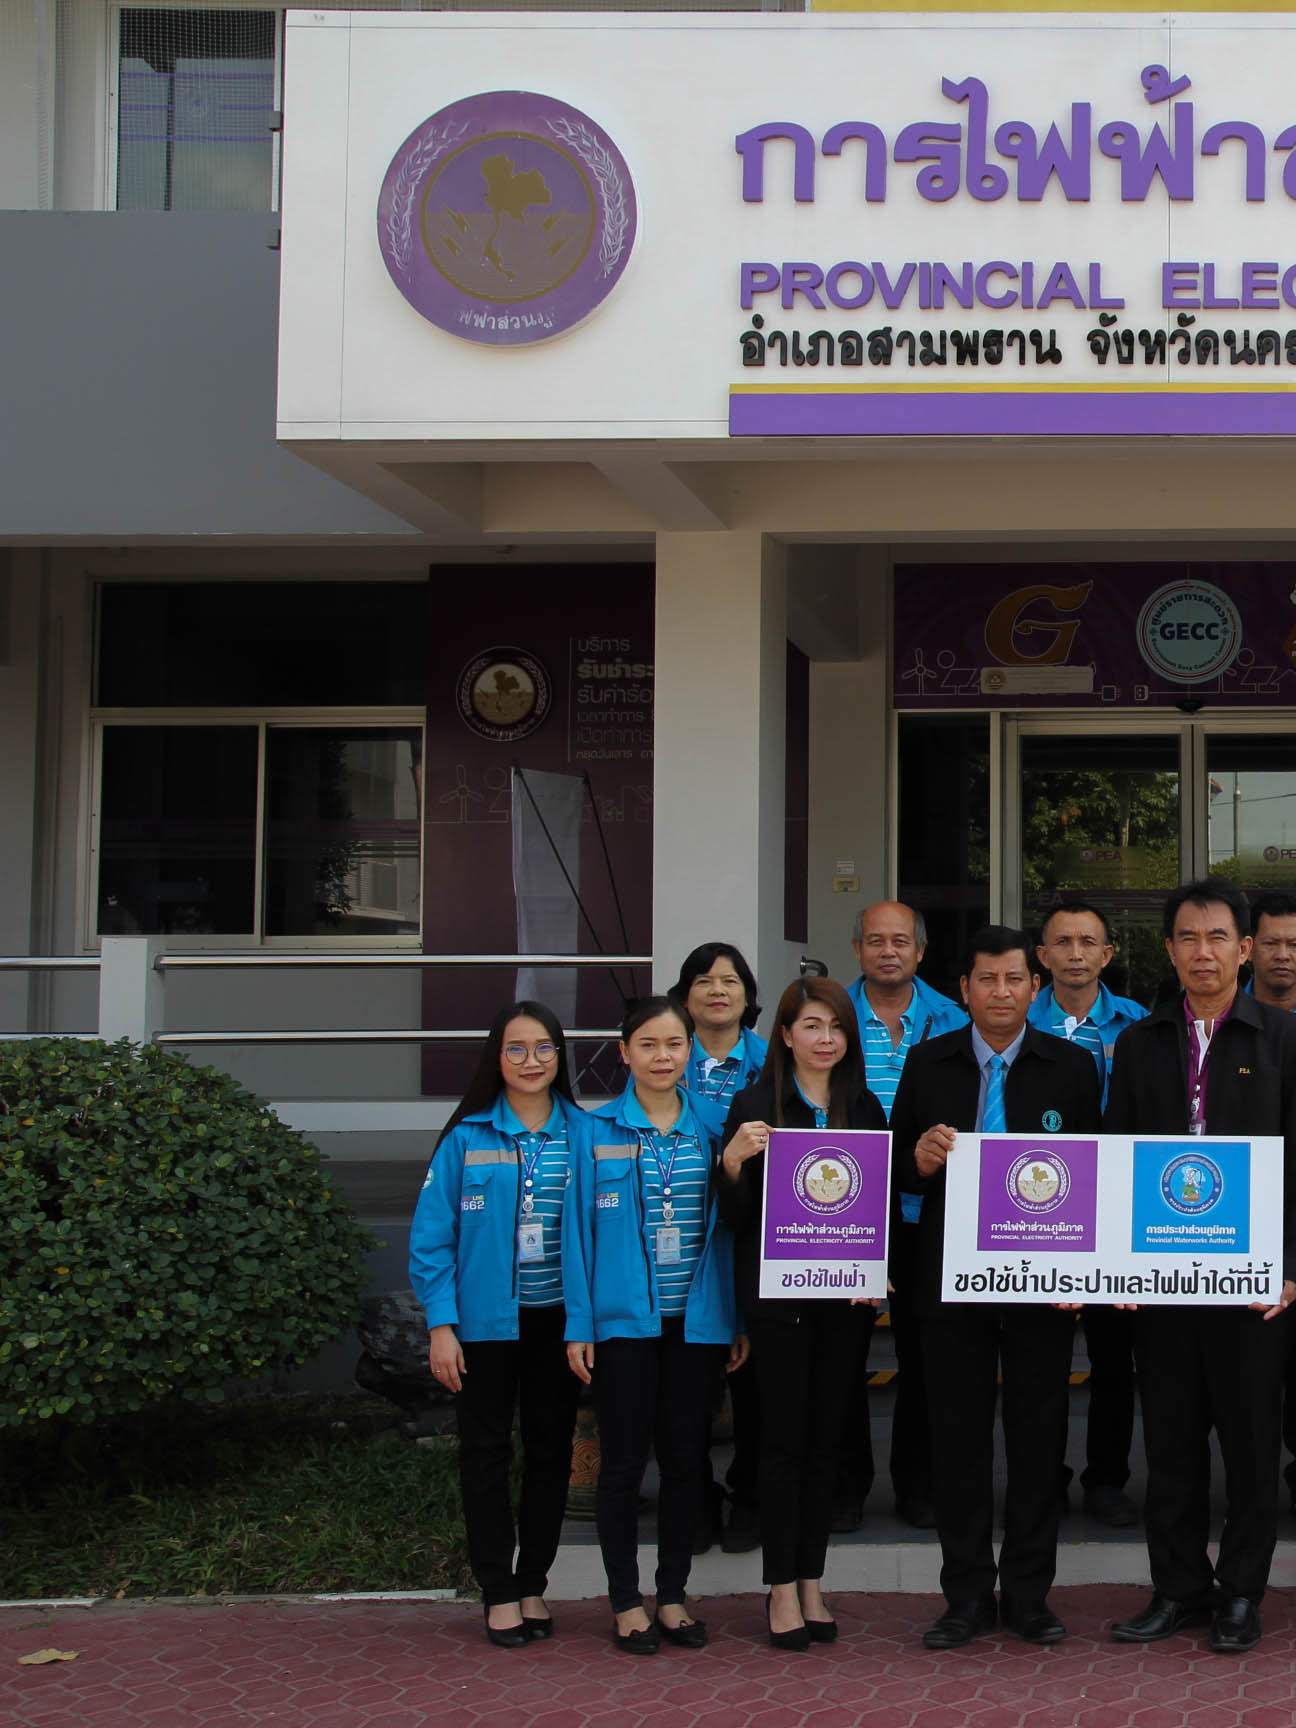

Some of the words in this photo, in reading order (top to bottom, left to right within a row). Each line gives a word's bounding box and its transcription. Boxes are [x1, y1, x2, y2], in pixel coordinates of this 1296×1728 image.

[740, 261, 1125, 309] PROVINCIAL
[740, 314, 1062, 366] อำเภอสามพราน
[1160, 622, 1219, 641] GECC
[776, 1223, 876, 1238] การไฟฟ้าส่วนภูมิภาค
[991, 1220, 1084, 1235] การไฟฟ้าส่วนภูมิภาค
[1146, 1224, 1236, 1237] การประปาส่วนภูมิภาค
[782, 1263, 866, 1288] ขอใช้ไฟฟ้า
[955, 1260, 1273, 1295] ขอใช้น้ำประปาและไฟฟ้าได้ที่นี้
